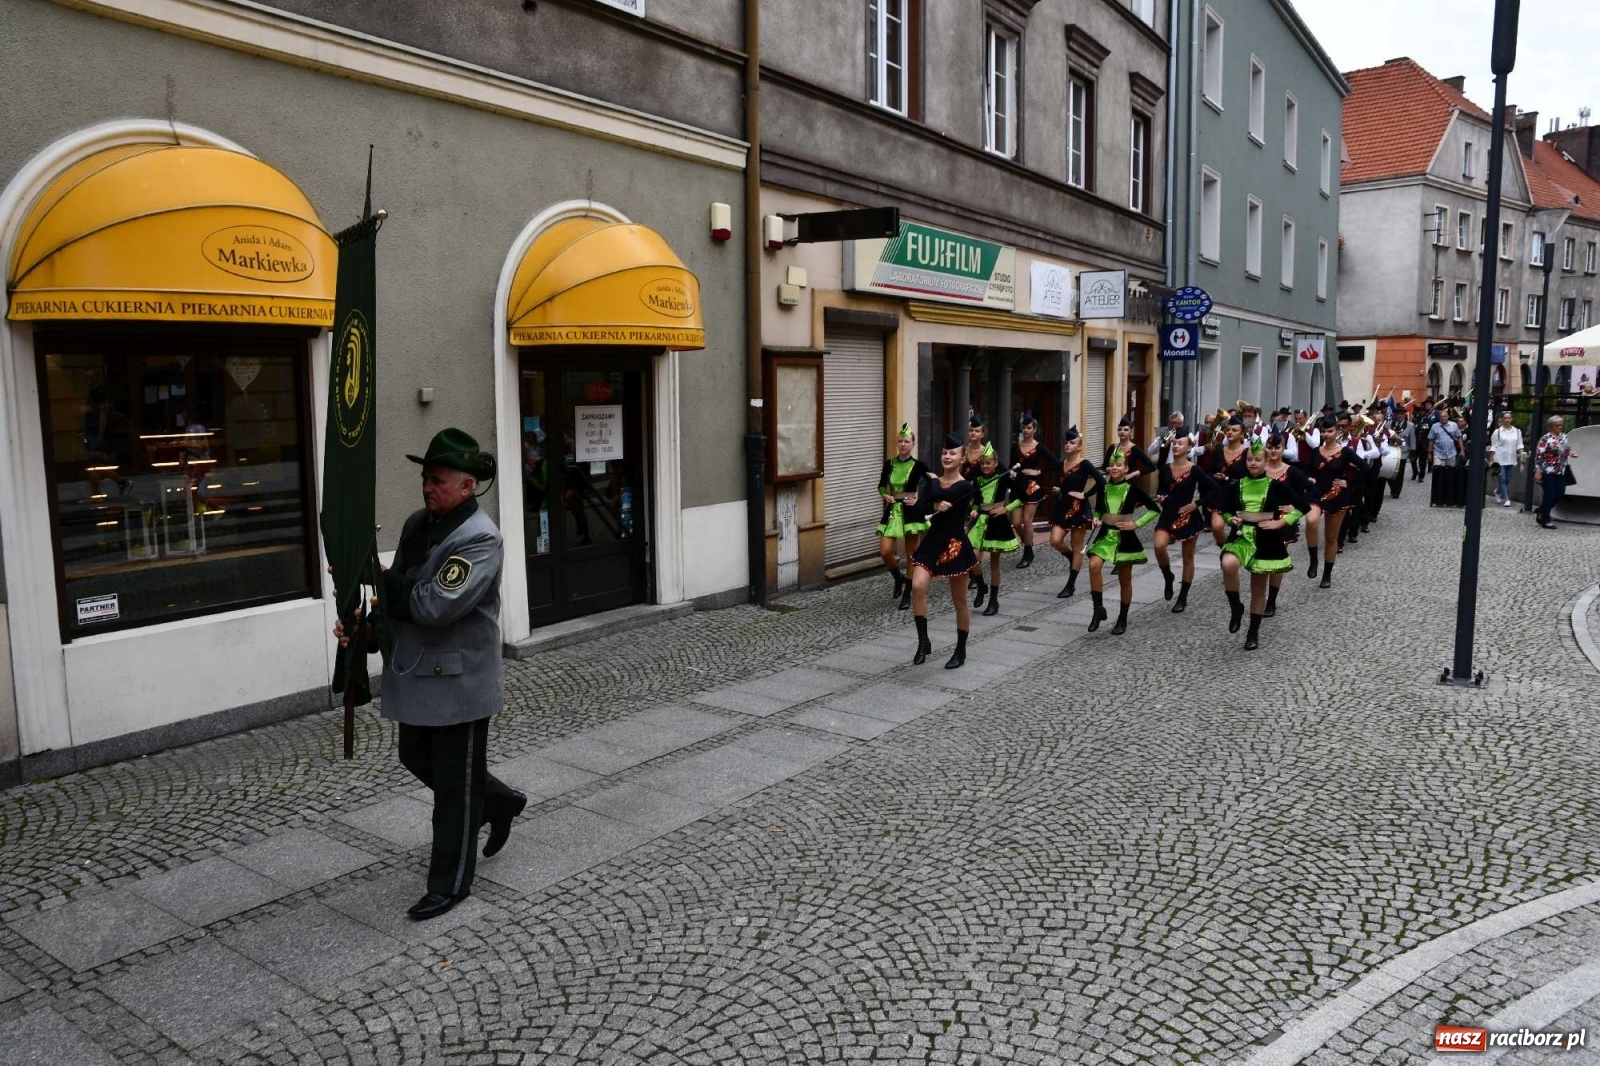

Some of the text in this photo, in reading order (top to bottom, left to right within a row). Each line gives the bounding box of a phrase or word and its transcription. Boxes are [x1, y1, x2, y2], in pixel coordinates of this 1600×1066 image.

[233, 235, 260, 245] Anida
[268, 237, 293, 252] Adam
[218, 248, 308, 273] Markiewka
[906, 232, 981, 274] FUJIFILM
[648, 294, 693, 311] Markiewka
[1085, 294, 1120, 306] ATELIER
[15, 301, 78, 314] PIEKARNIA
[82, 300, 175, 314] CUKIERNIA
[181, 302, 267, 317] PIEKARNIA
[269, 305, 328, 320] CUKIERNIA
[513, 331, 563, 341] PIEKARNIA
[565, 331, 627, 340] CUKIERNIA
[629, 331, 677, 342] PIEKARNIA
[1164, 349, 1195, 357] Monetia
[79, 602, 116, 613] PARTNER
